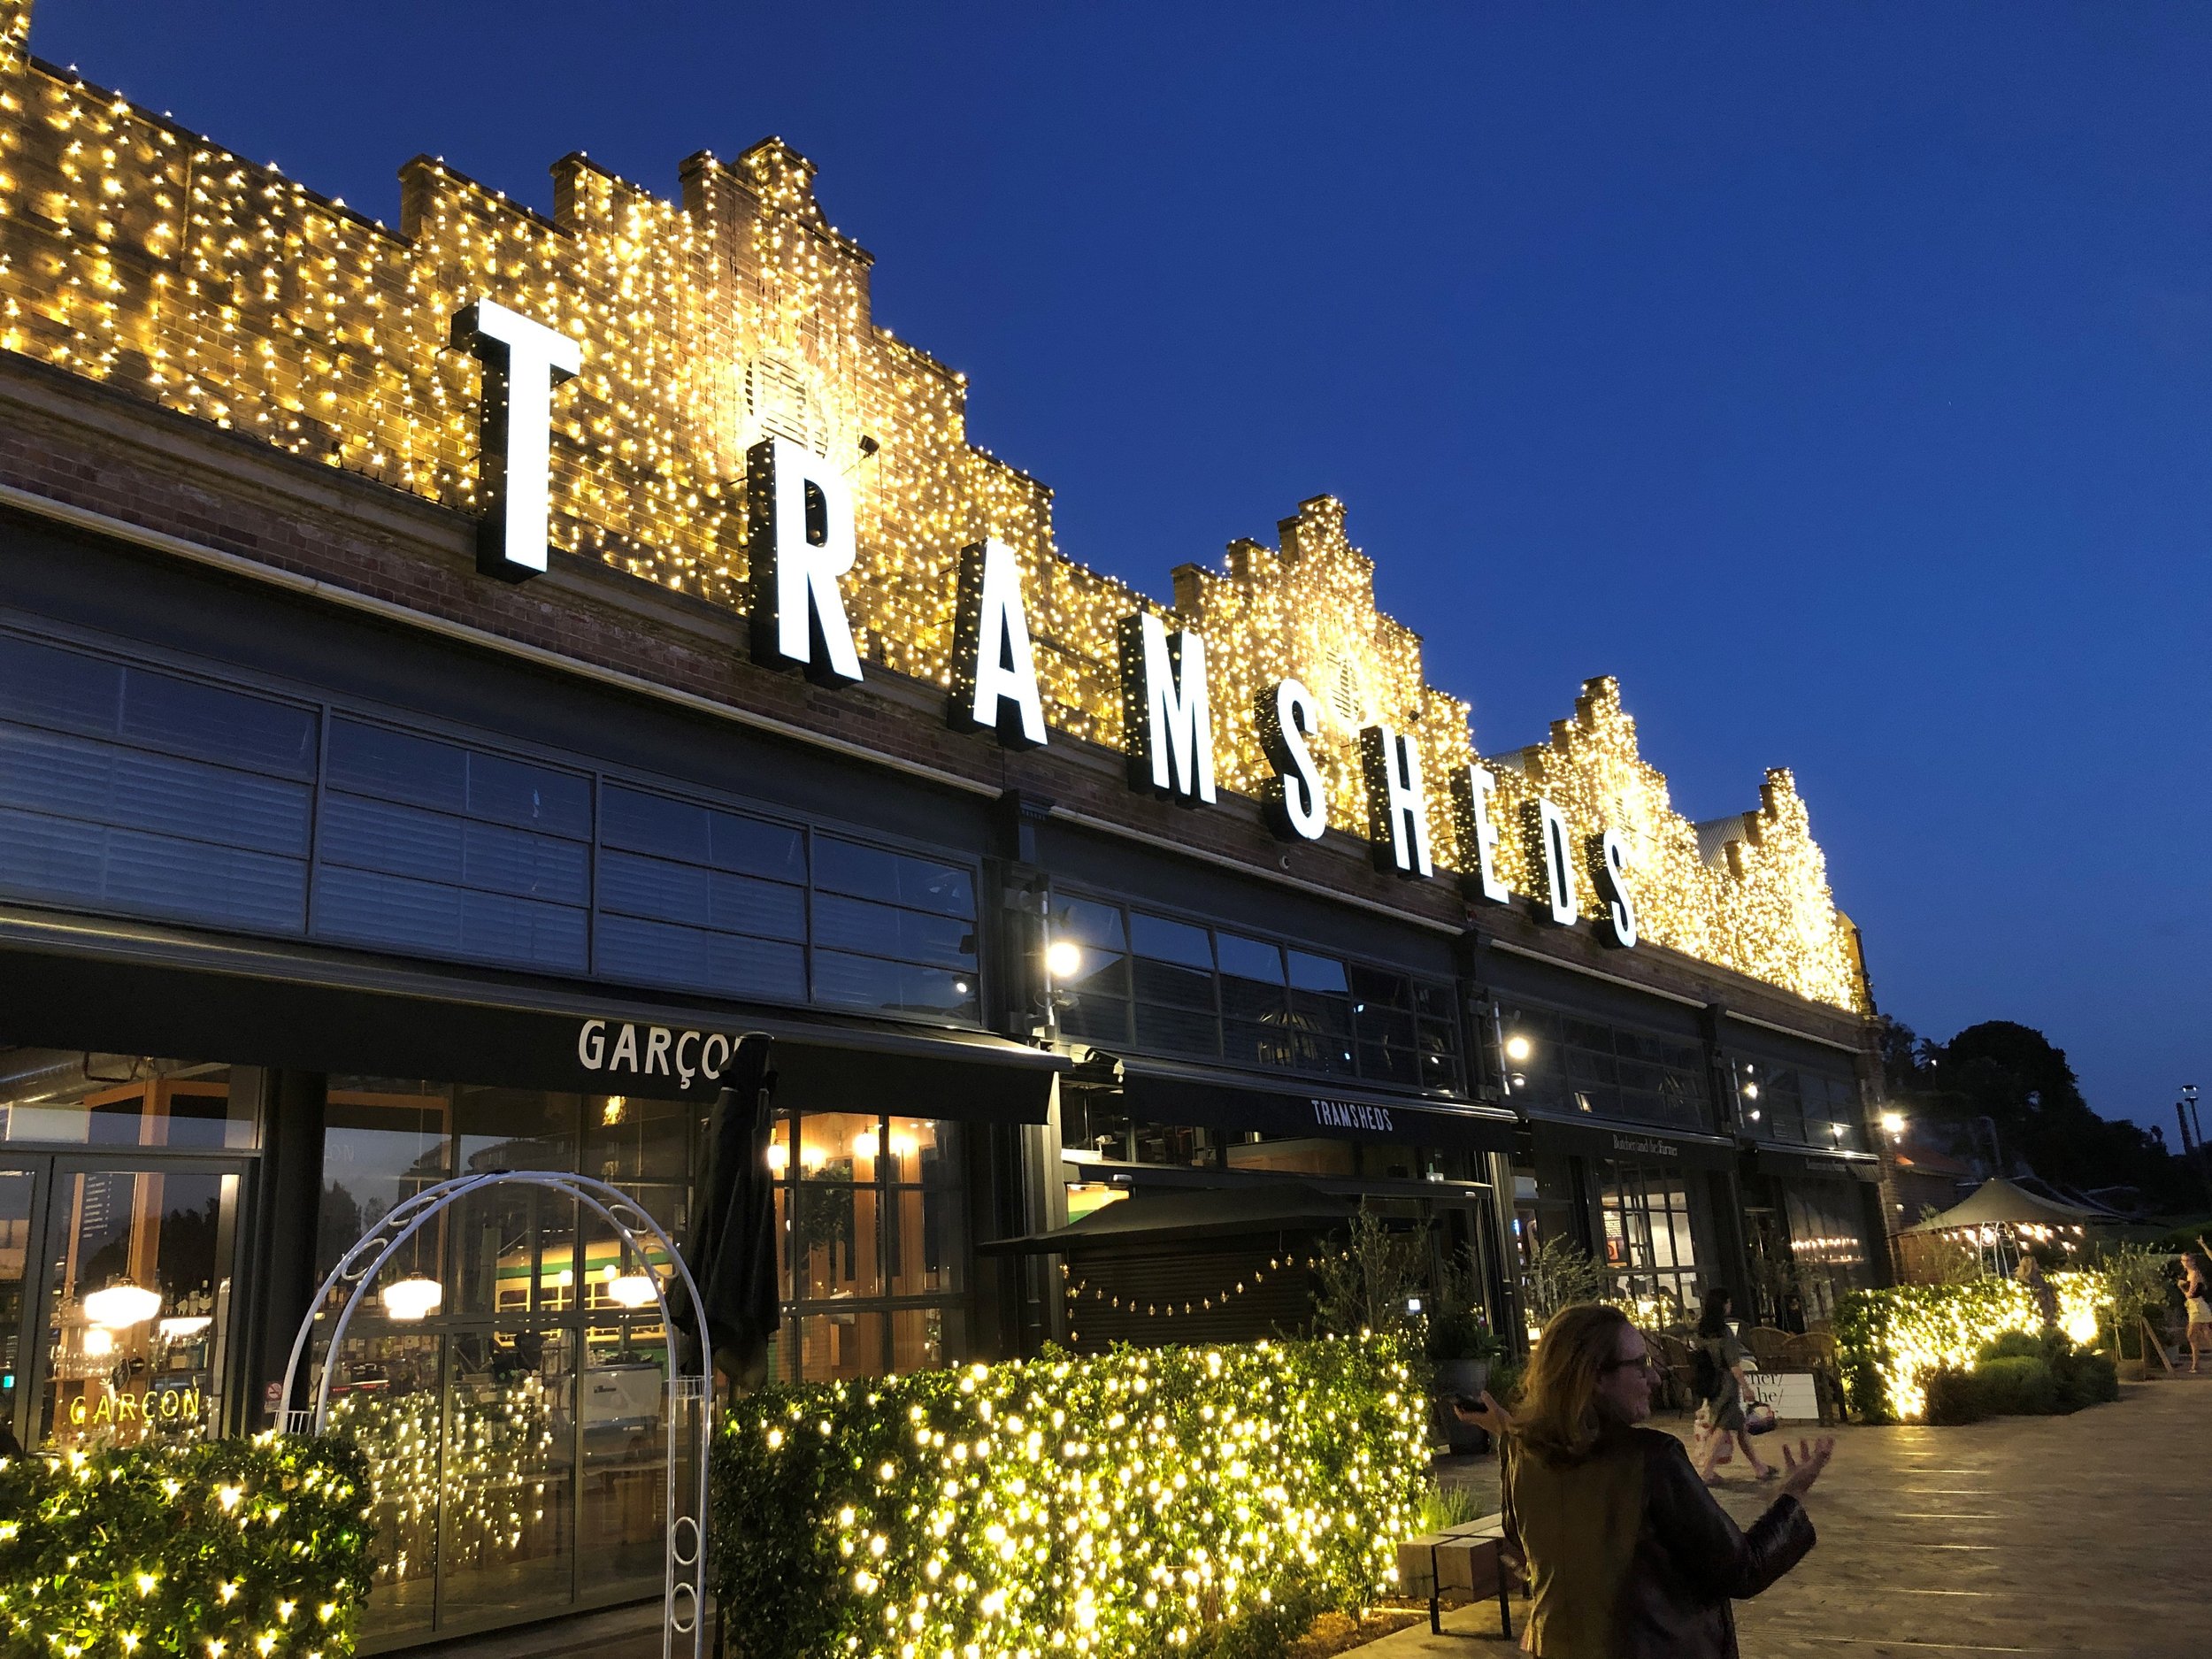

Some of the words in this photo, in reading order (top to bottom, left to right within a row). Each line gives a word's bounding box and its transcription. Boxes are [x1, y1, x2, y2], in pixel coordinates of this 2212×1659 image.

[478, 297, 1637, 948] TRAMSHEDS
[578, 1019, 743, 1089] GARÇO
[1310, 1100, 1393, 1131] TRAMSHEDS
[70, 1388, 200, 1427] GARÇON
